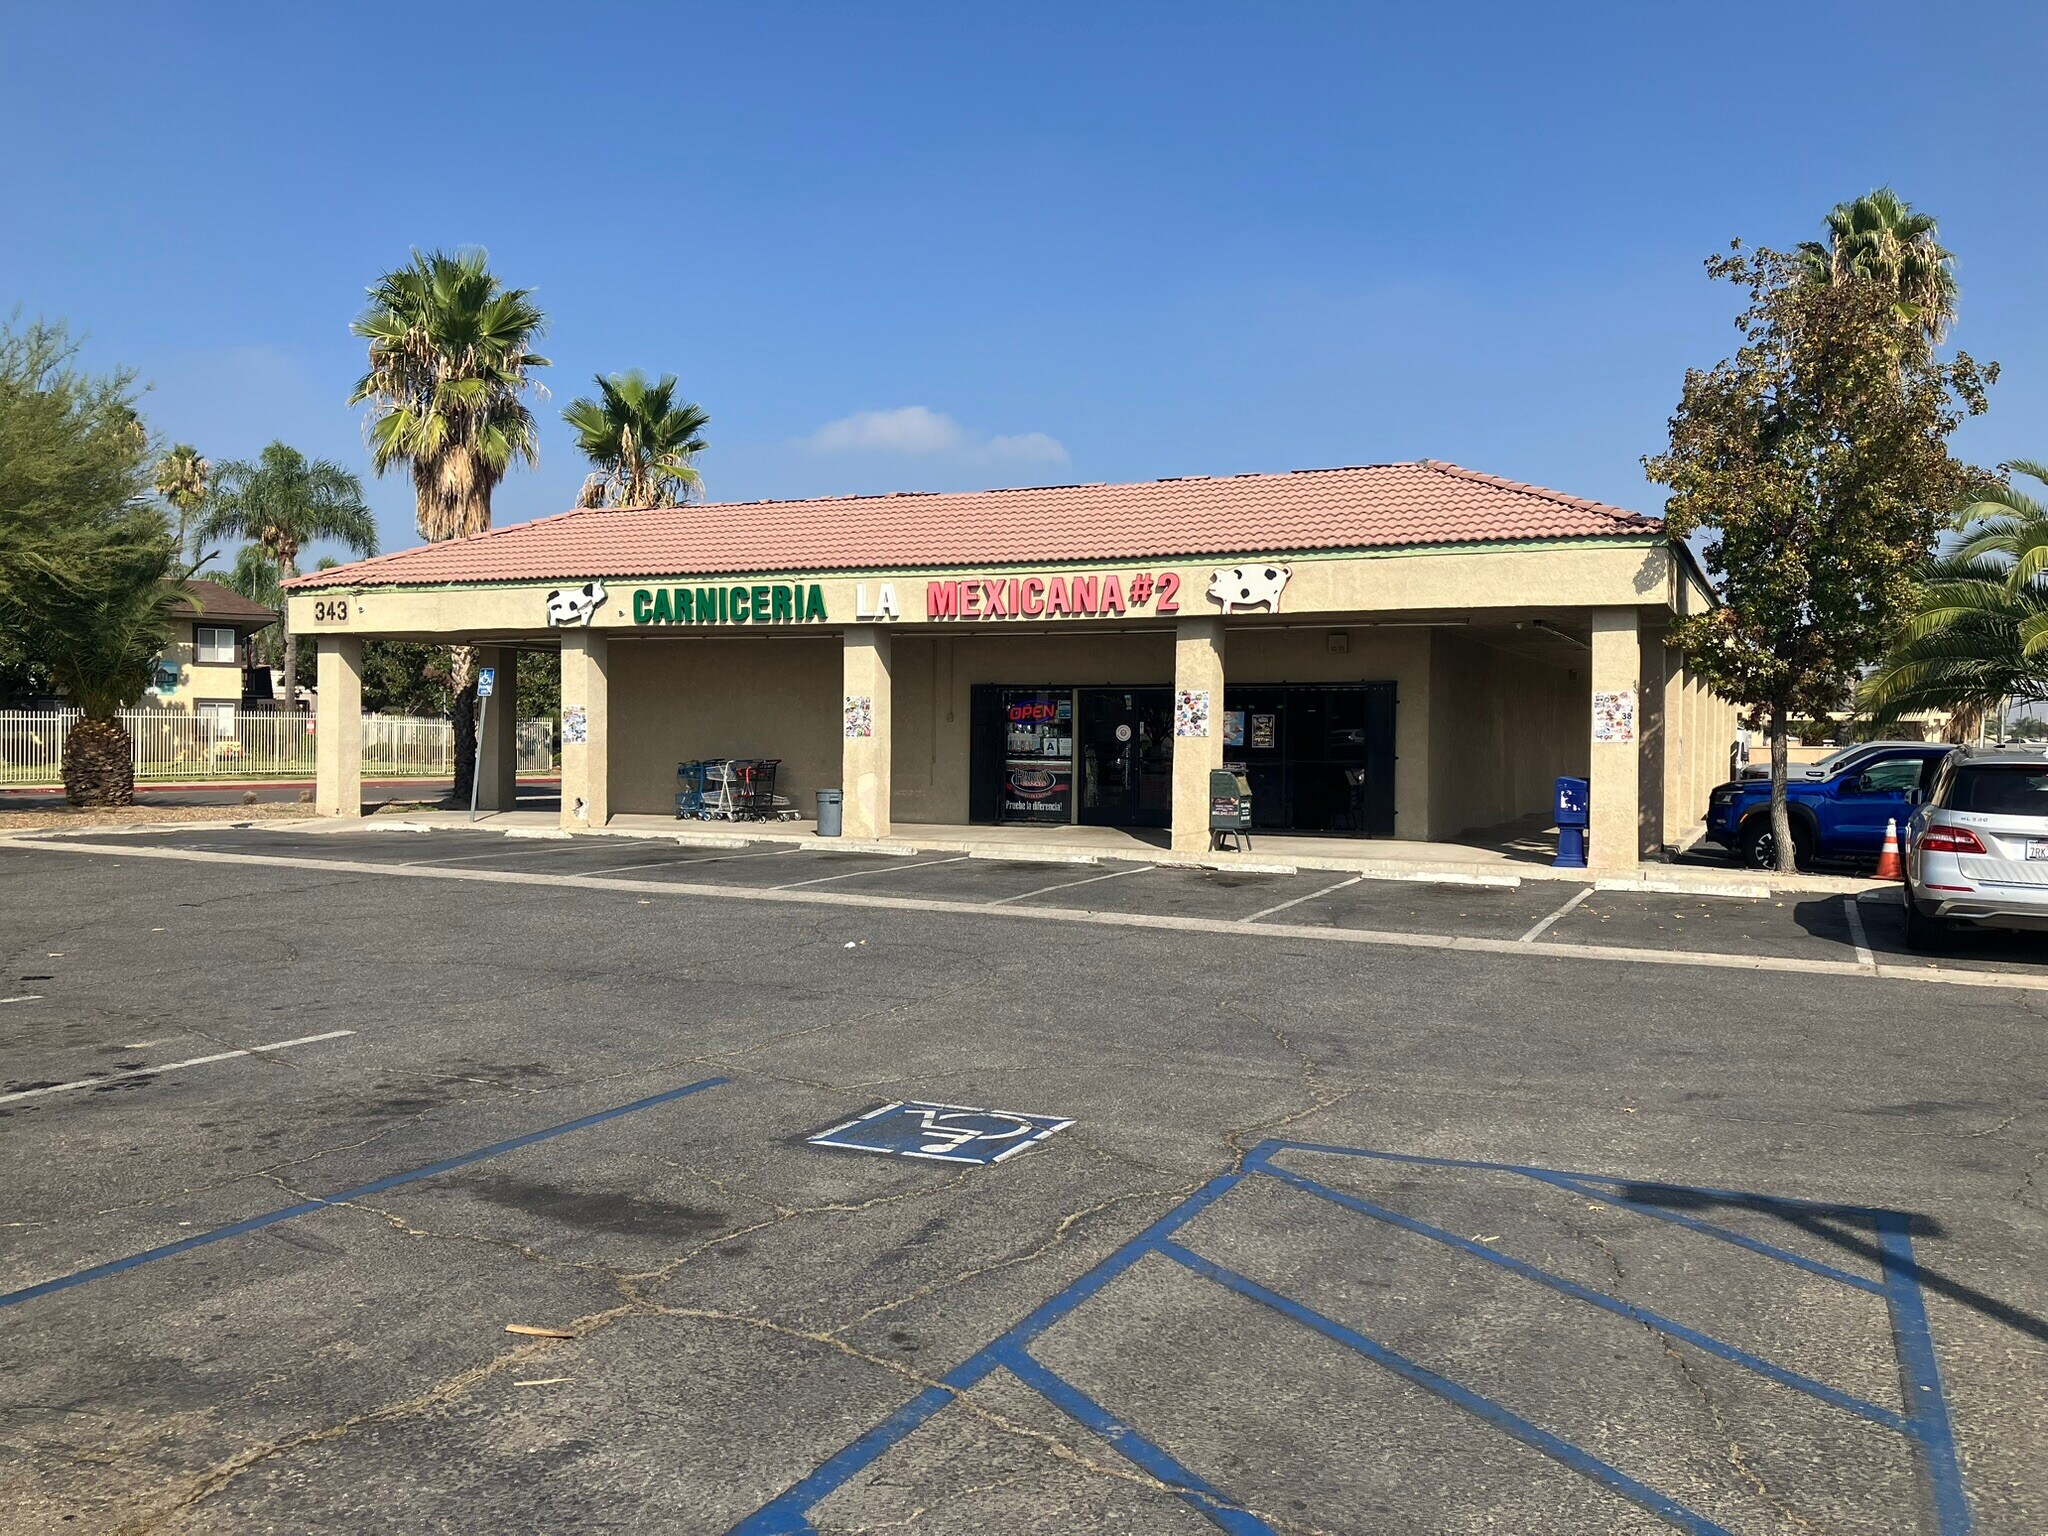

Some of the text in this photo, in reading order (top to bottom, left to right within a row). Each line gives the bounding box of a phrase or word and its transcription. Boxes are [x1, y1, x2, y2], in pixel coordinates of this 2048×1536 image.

[633, 584, 828, 624] CARNICERIA
[856, 582, 899, 620] LA
[927, 575, 1126, 618] MEXICANA
[315, 601, 347, 621] 343
[1009, 704, 1055, 720] OPEN
[1046, 742, 1055, 751] A
[1005, 800, 1026, 810] Pruebe
[1026, 801, 1032, 810] la
[2030, 847, 2048, 858] 7RK
